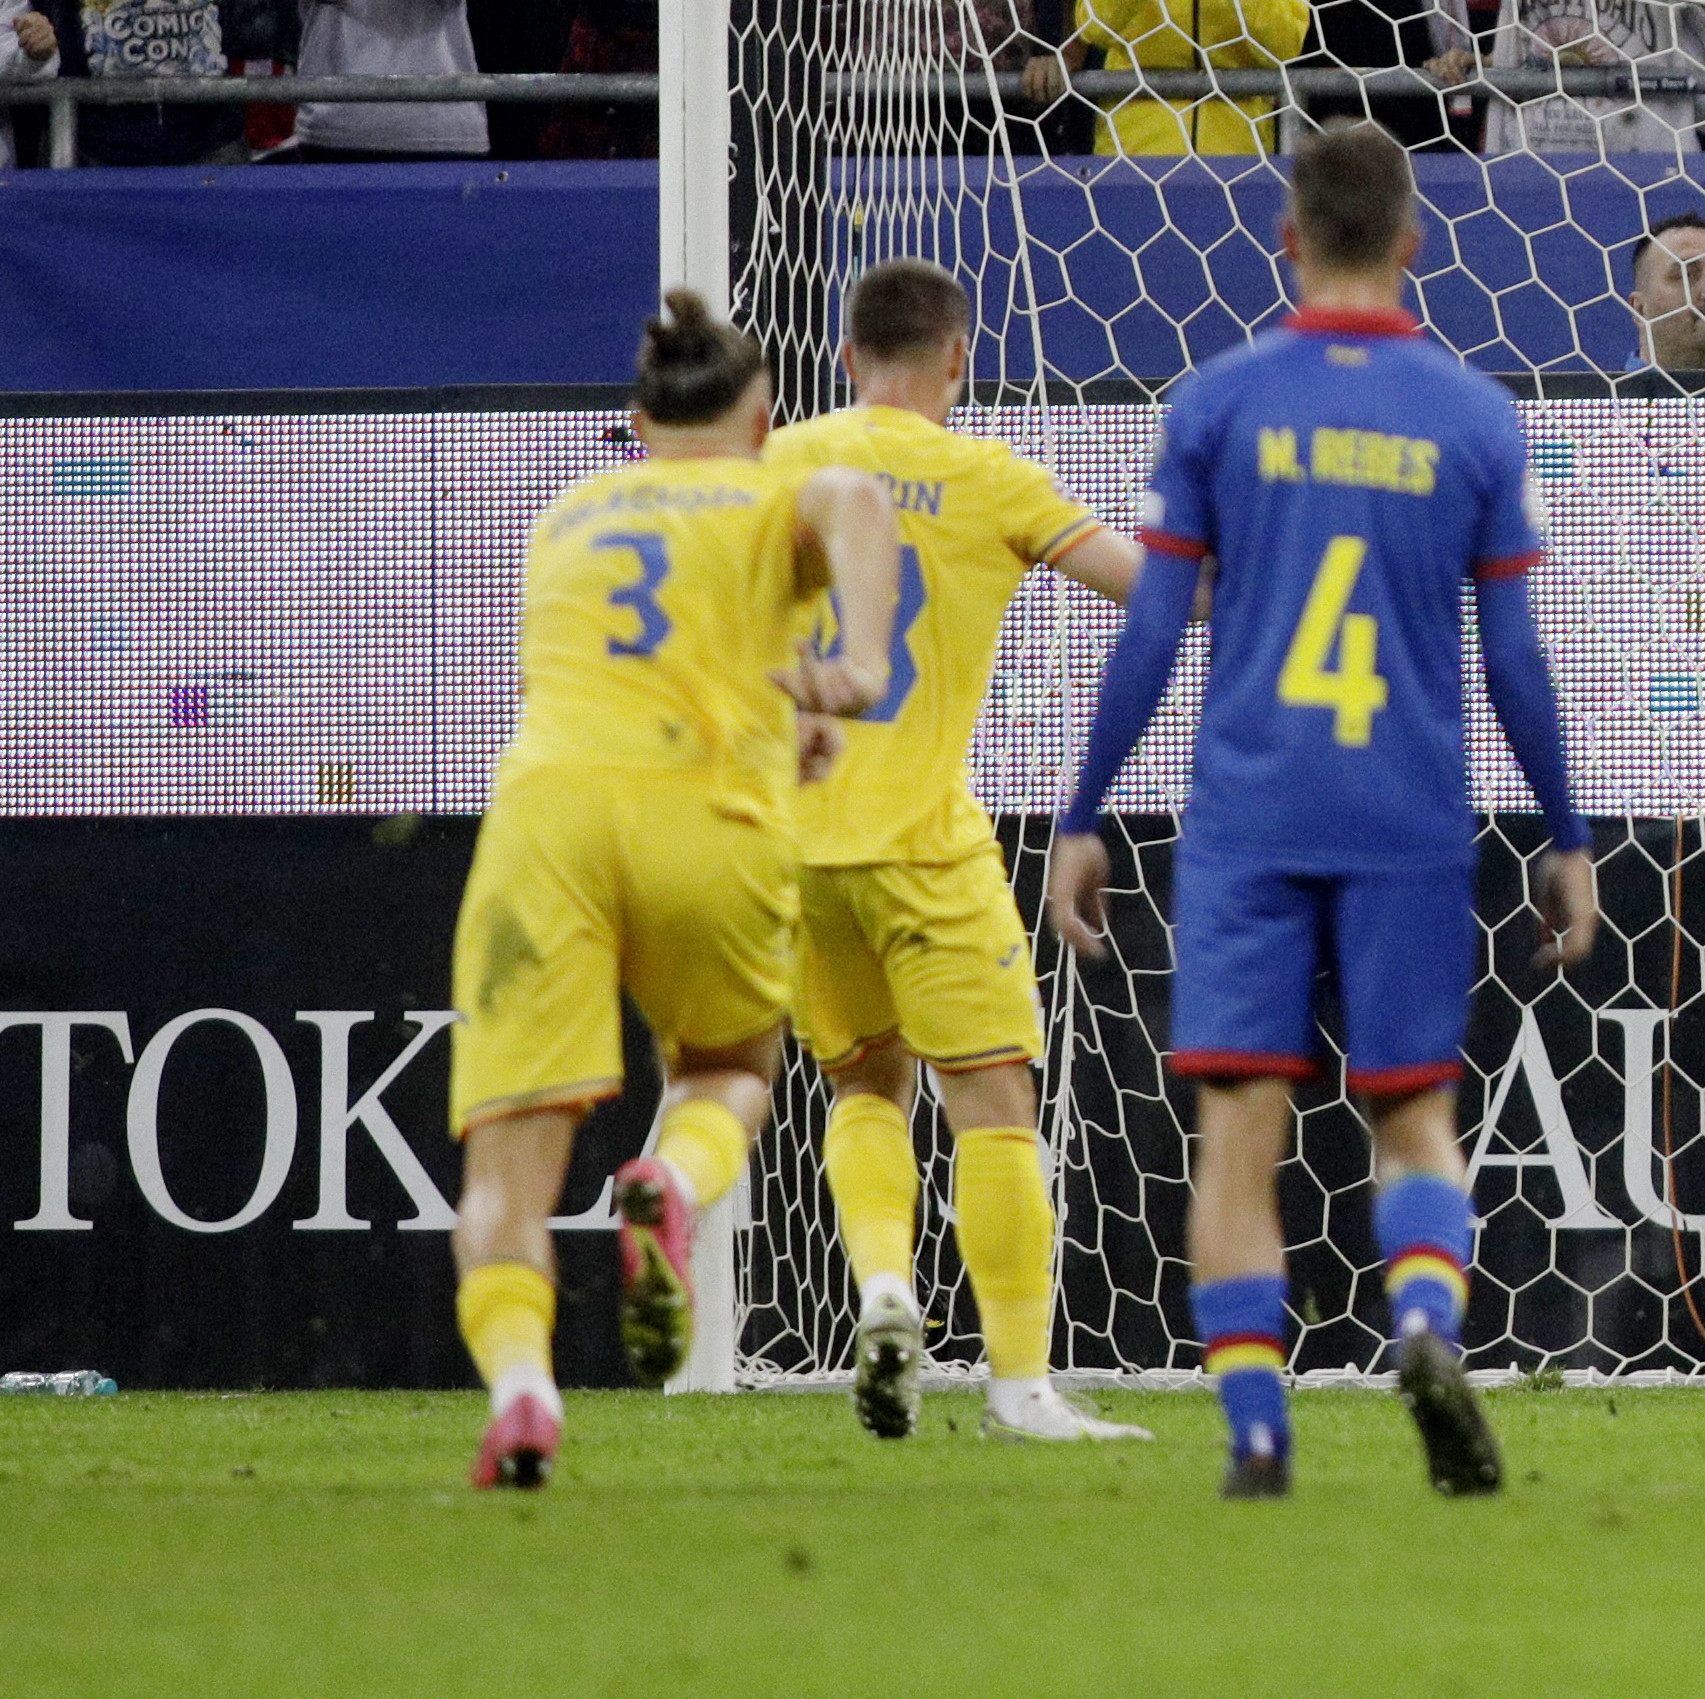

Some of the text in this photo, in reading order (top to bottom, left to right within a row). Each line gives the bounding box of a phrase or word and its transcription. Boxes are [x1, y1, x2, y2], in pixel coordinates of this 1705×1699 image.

[103, 10, 205, 40] COMIC
[122, 36, 190, 64] CON
[592, 531, 670, 657] 3
[1278, 536, 1388, 747] 4
